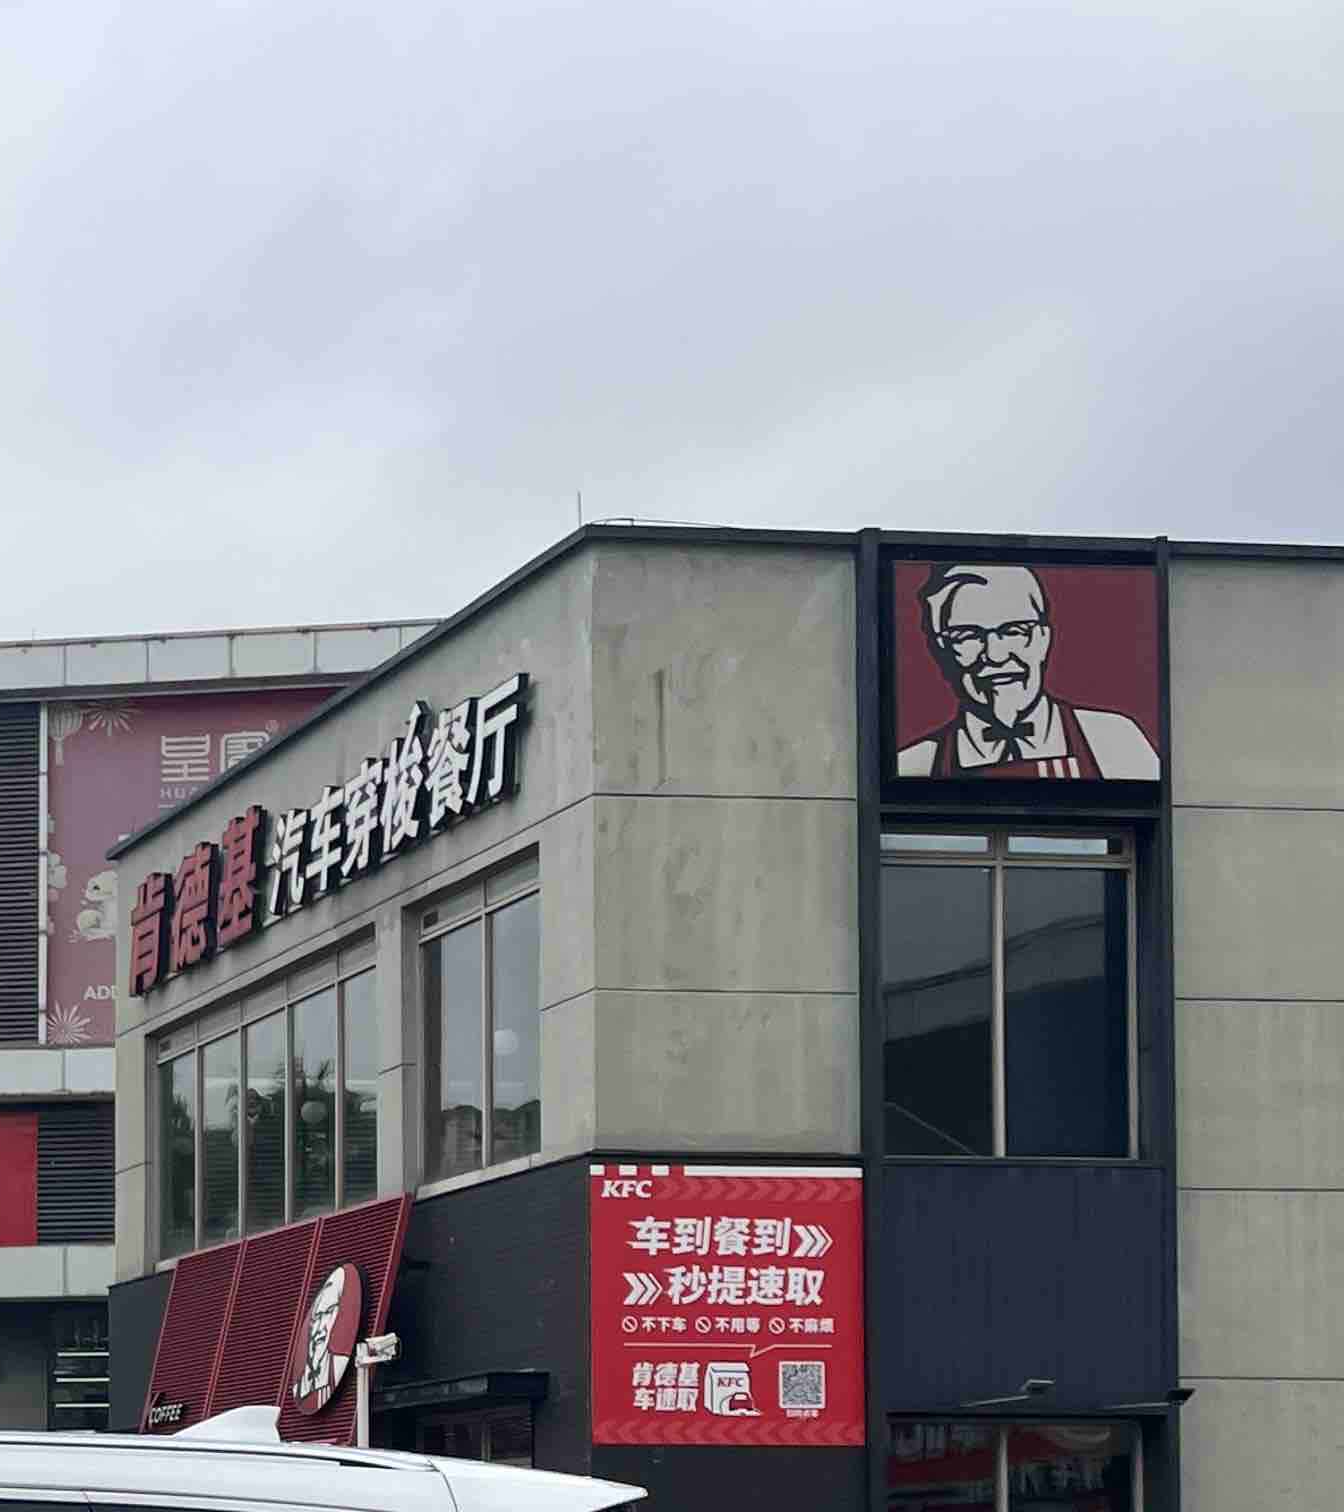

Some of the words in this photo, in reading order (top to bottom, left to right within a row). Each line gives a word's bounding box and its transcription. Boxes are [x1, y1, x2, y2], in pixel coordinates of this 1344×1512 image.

[129, 806, 260, 995] 肯德基
[270, 674, 519, 914] 汽车穿梭餐厅
[601, 1179, 653, 1198] KFC
[627, 1216, 791, 1256] 车到餐到
[665, 1265, 825, 1306] 秒提速取
[642, 1316, 687, 1333] 不下车
[715, 1317, 761, 1334] 不用等
[632, 1362, 700, 1387] 肯德基
[717, 1377, 744, 1388] KFC
[149, 1403, 183, 1424] COFFEE
